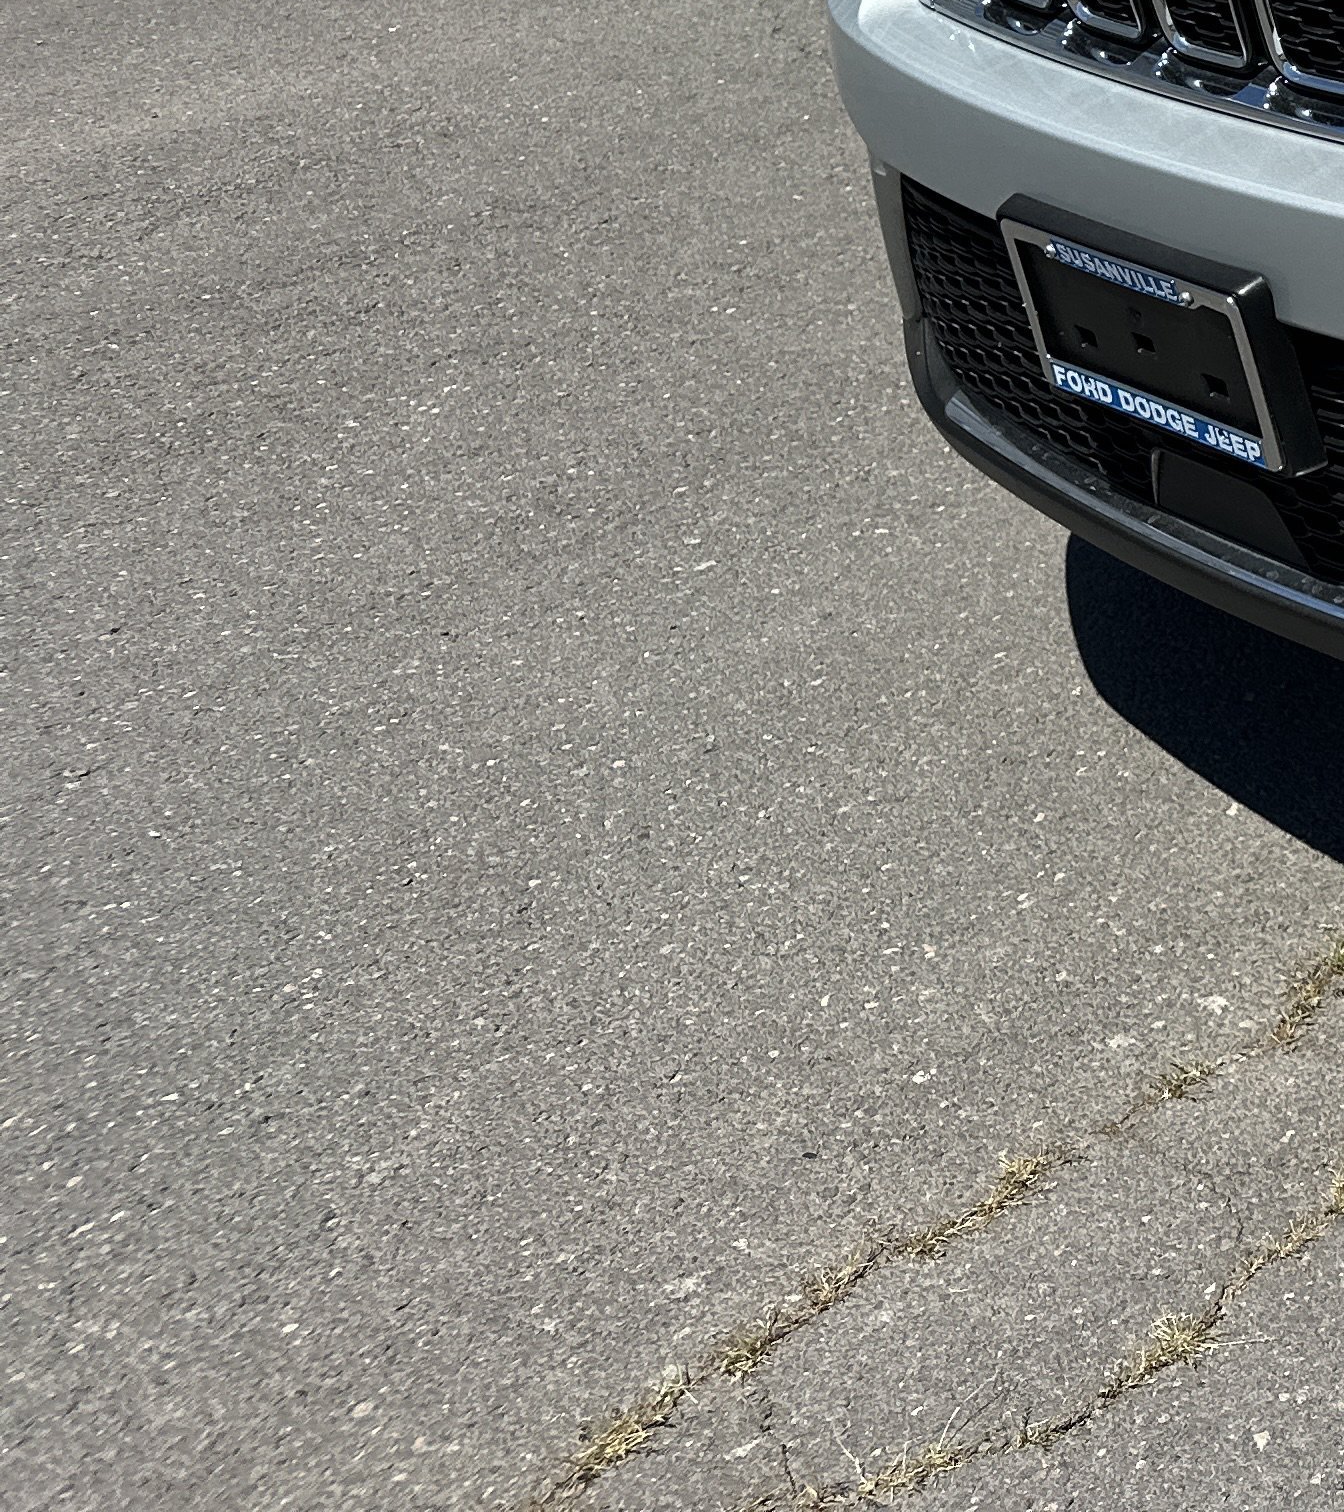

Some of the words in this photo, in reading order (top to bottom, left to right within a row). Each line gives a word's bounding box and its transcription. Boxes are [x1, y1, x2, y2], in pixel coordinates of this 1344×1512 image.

[1055, 242, 1179, 301] SUSANVILLE
[1117, 388, 1199, 438] DODGE
[1203, 422, 1262, 462] JEEP
